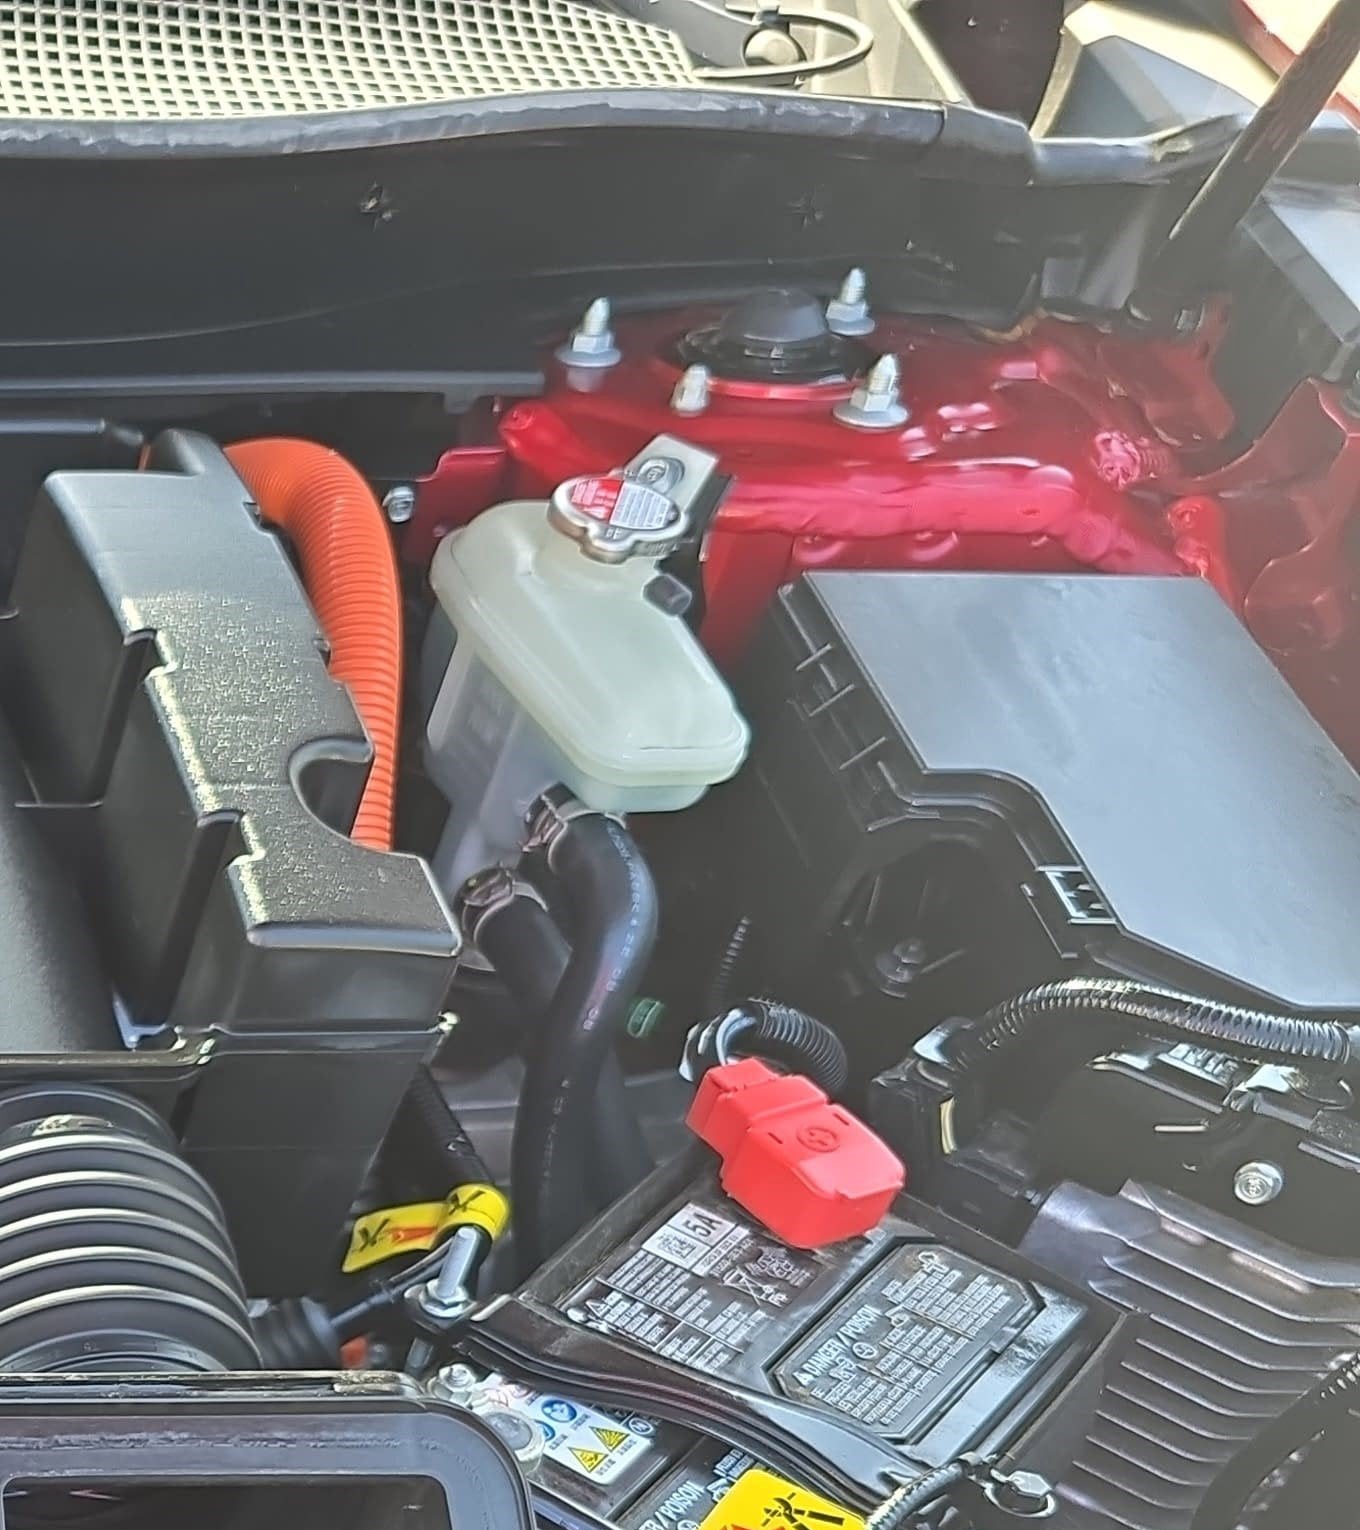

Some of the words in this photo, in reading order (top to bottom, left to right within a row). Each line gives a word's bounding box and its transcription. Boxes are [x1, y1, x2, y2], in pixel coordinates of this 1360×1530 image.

[685, 1212, 725, 1240] 5A
[801, 1336, 847, 1375] DANGER
[838, 1303, 883, 1340] POISON
[657, 1478, 706, 1521] POISON
